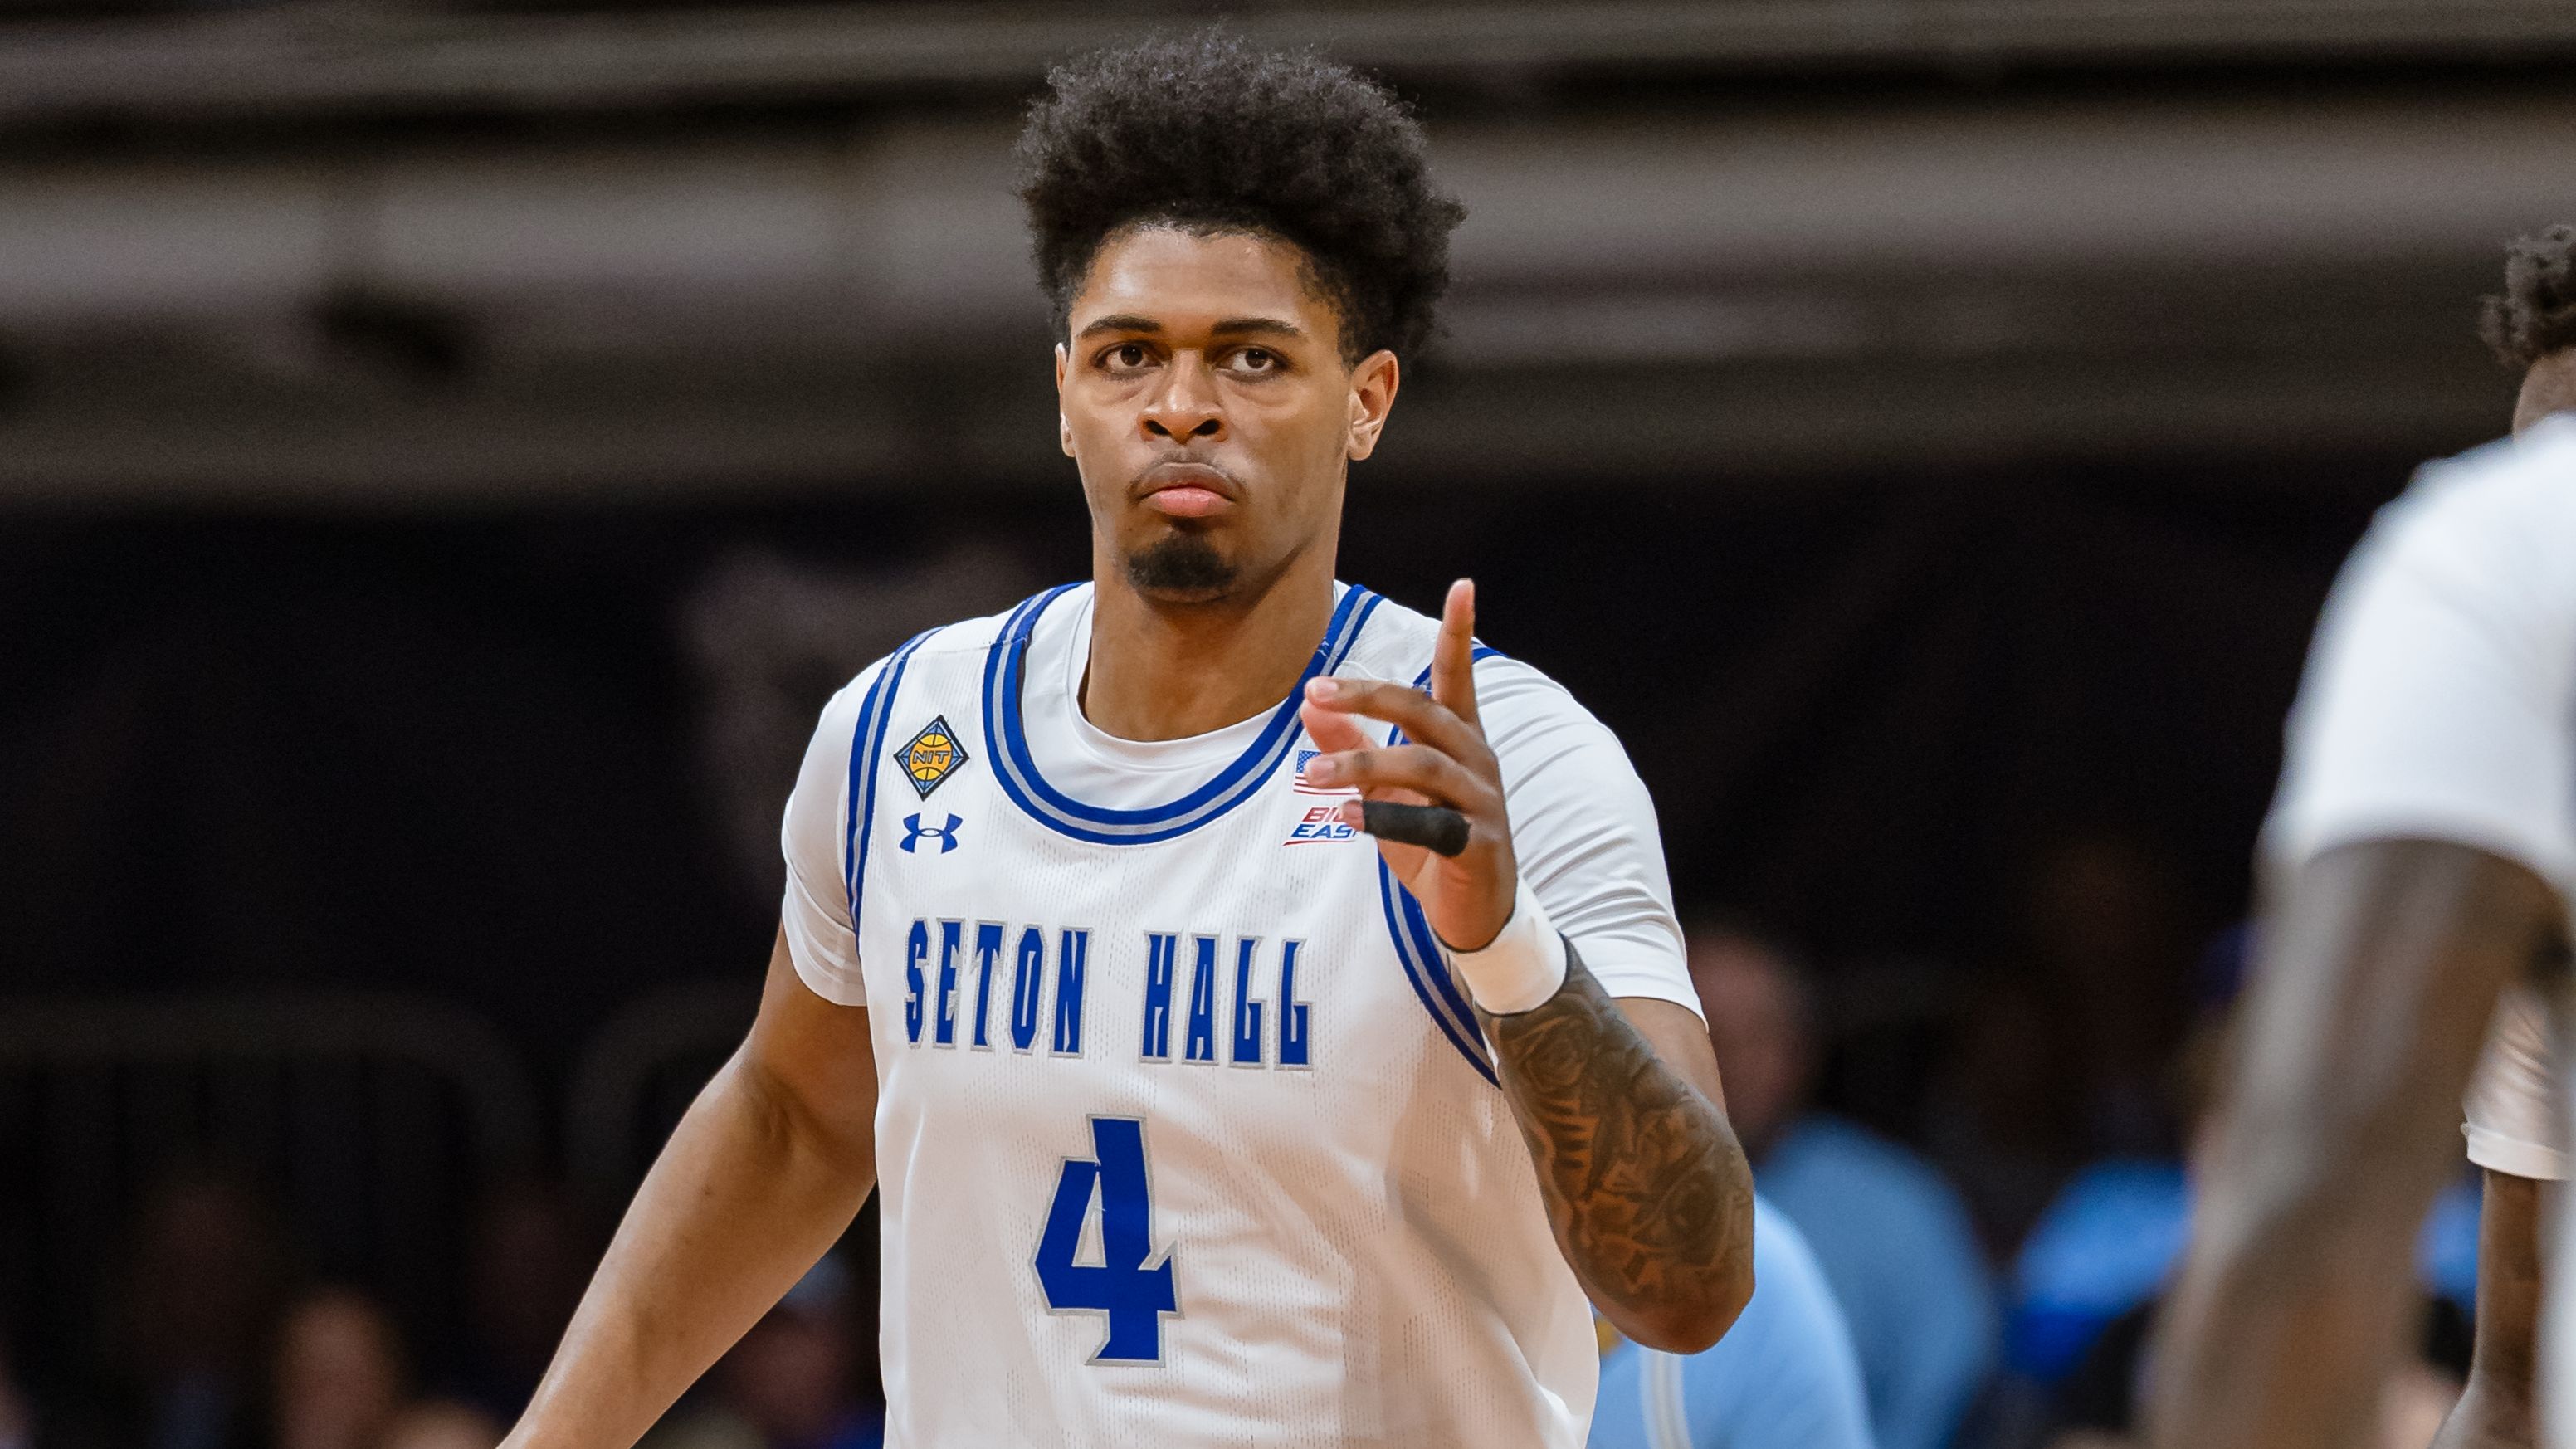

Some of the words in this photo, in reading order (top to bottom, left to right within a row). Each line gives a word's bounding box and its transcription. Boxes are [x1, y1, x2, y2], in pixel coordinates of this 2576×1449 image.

[913, 750, 951, 764] NIT
[904, 917, 1094, 1059] SETON
[1139, 929, 1315, 1071] HALL
[1028, 1114, 1185, 1368] 4
